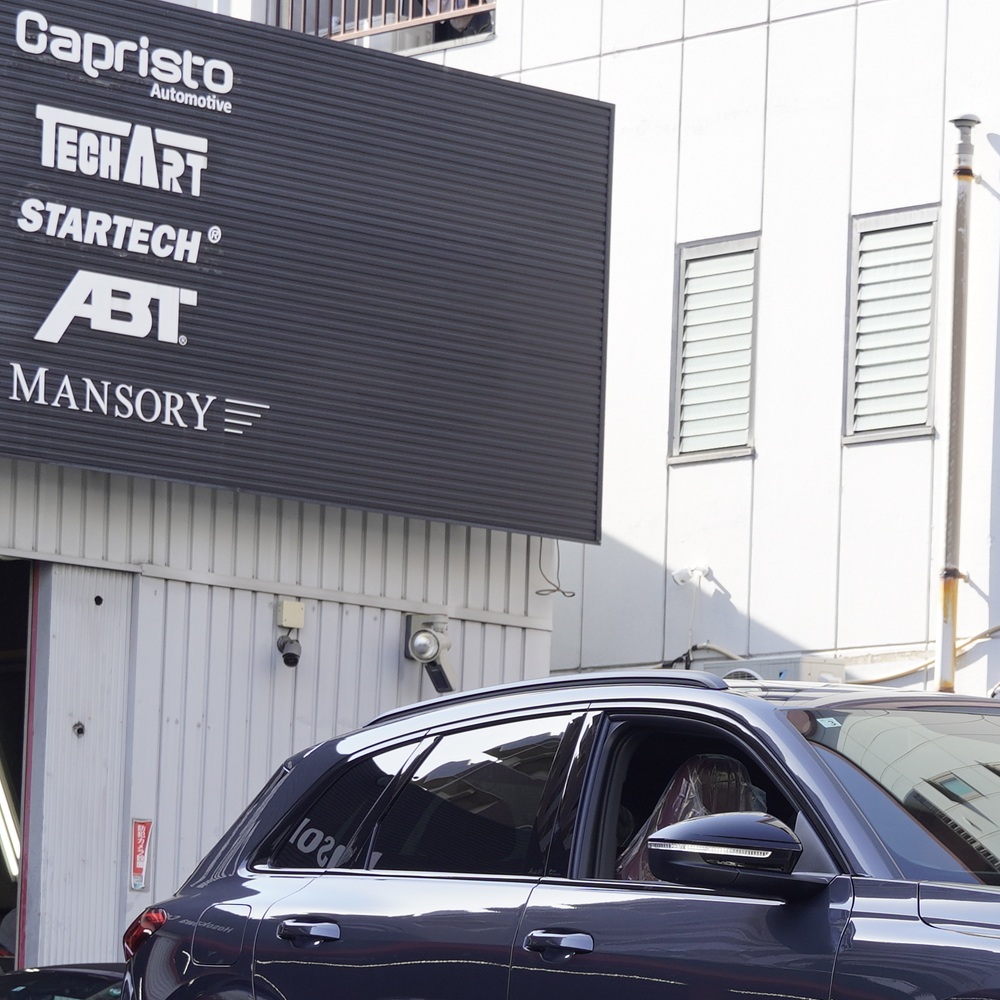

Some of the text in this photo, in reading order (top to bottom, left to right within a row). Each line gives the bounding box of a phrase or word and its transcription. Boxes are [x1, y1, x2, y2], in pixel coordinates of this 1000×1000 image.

[15, 9, 234, 95] Capristo
[149, 82, 233, 114] Automotive
[8, 362, 217, 431] MANSORY
